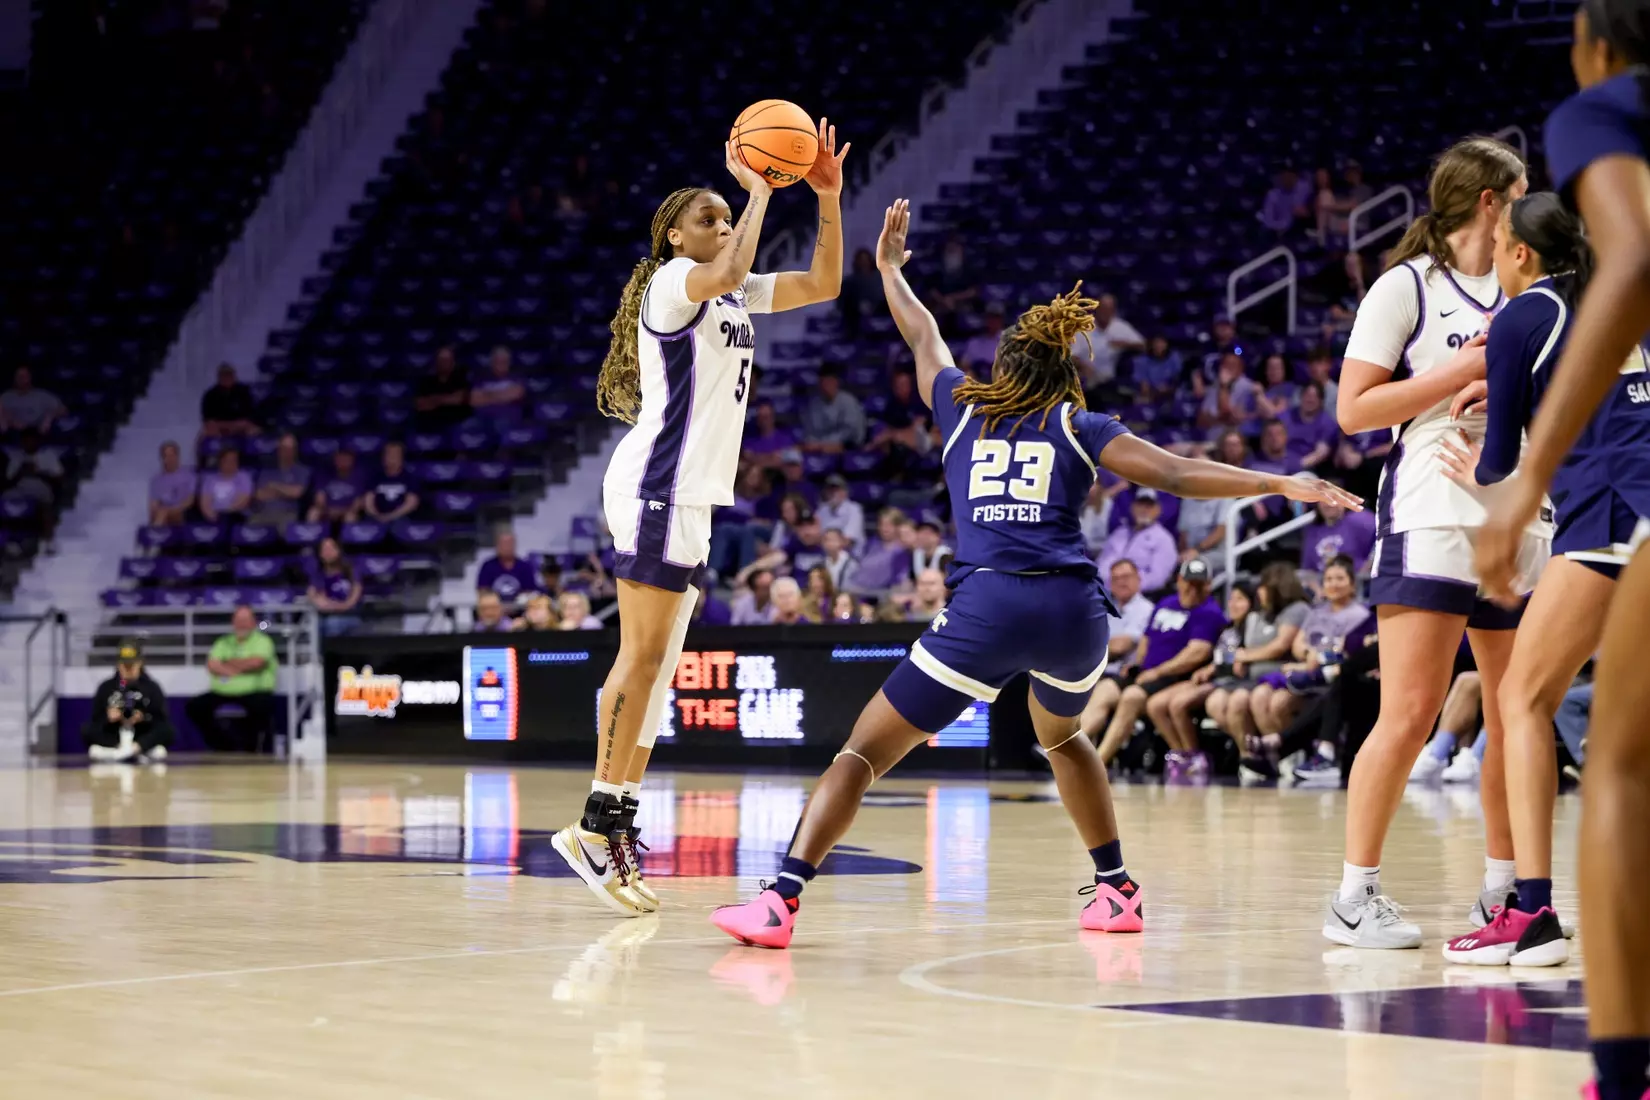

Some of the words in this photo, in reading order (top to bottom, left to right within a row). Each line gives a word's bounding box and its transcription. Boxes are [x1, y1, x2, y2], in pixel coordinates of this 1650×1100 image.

[735, 358, 750, 405] 5
[968, 439, 1056, 504] 23
[972, 504, 1041, 523] FOSTER
[677, 699, 737, 727] THE
